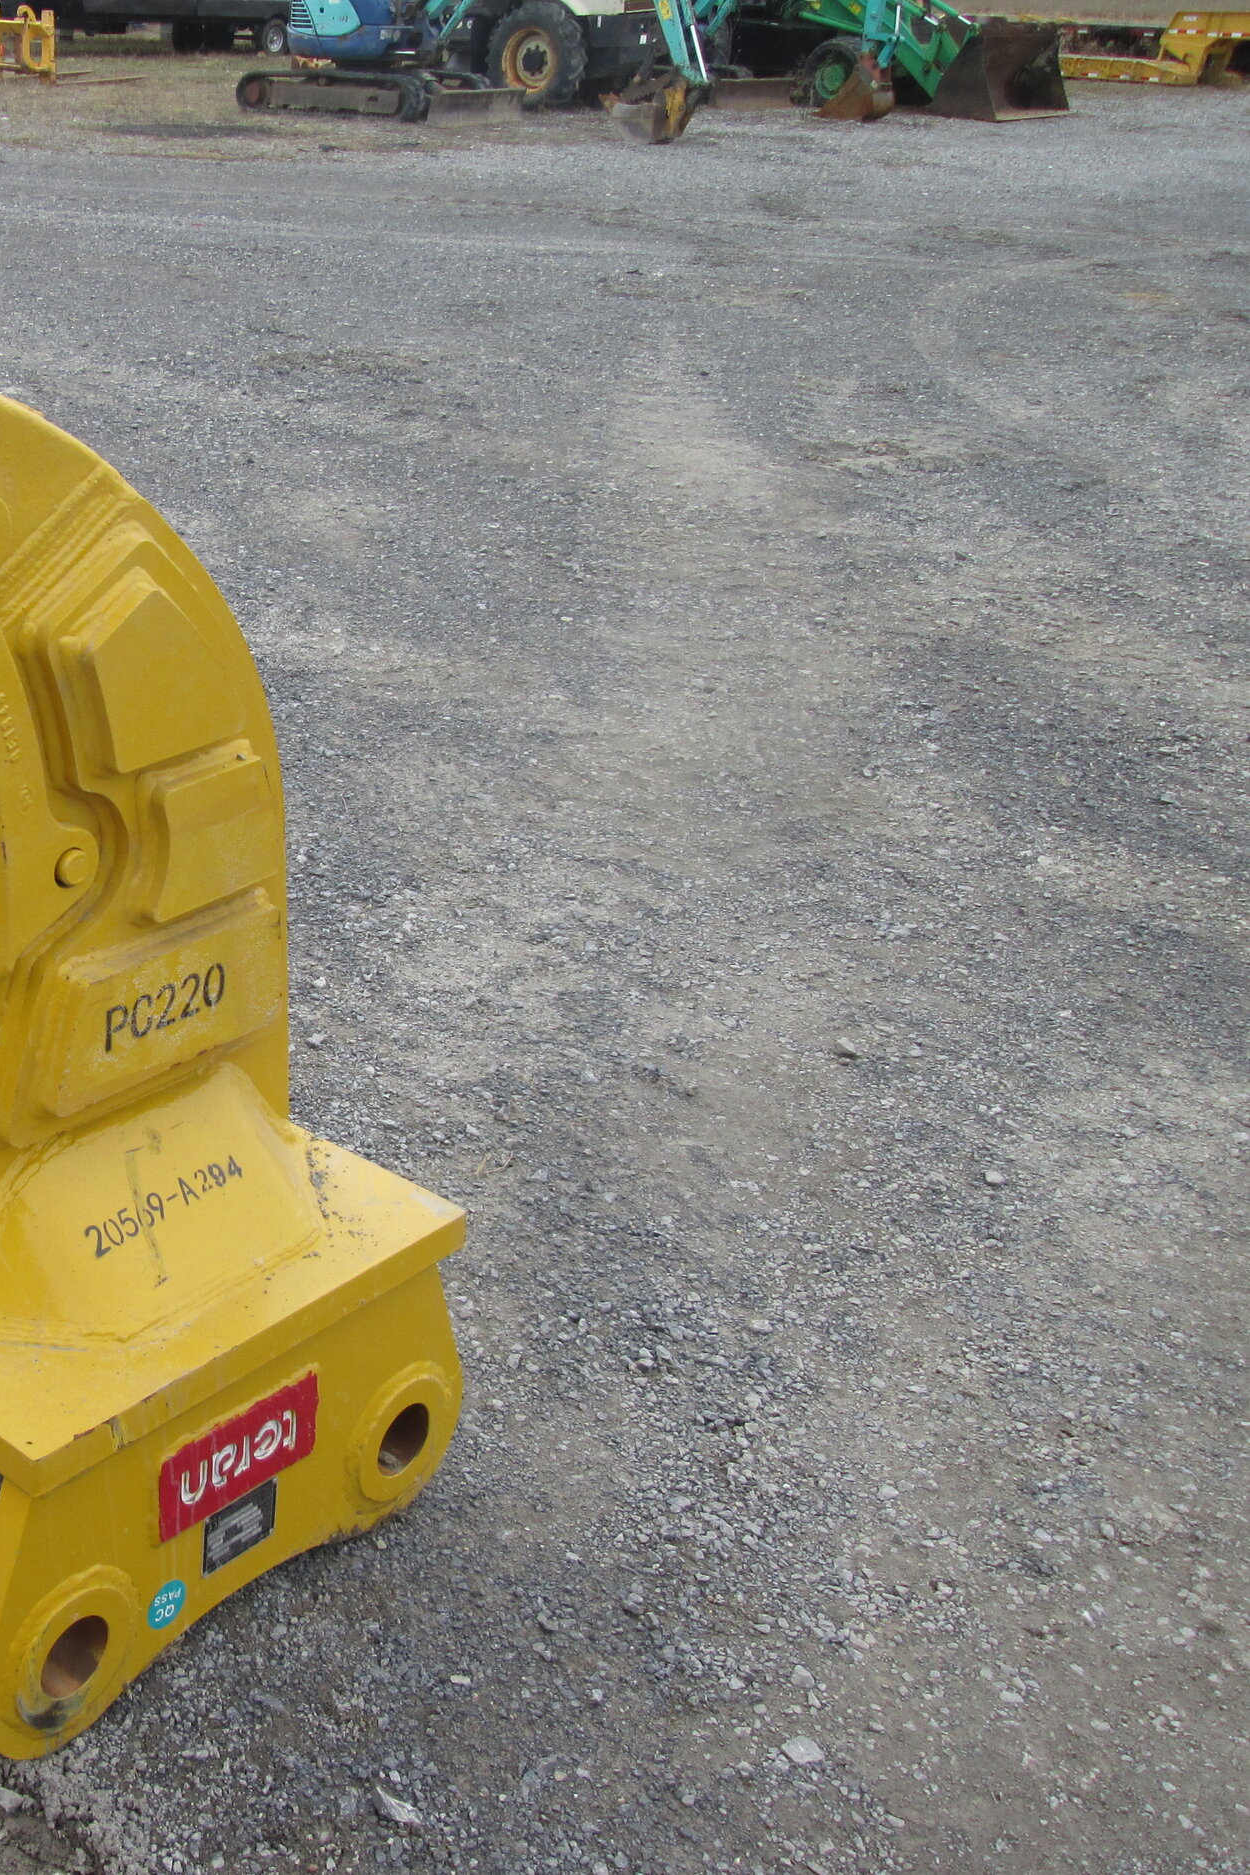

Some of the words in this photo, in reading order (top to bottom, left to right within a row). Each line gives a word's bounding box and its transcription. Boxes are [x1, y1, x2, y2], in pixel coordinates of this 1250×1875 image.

[104, 962, 226, 1053] PC220
[180, 1408, 297, 1505] teran
[155, 1588, 182, 1606] PASS
[155, 1604, 175, 1622] QC
